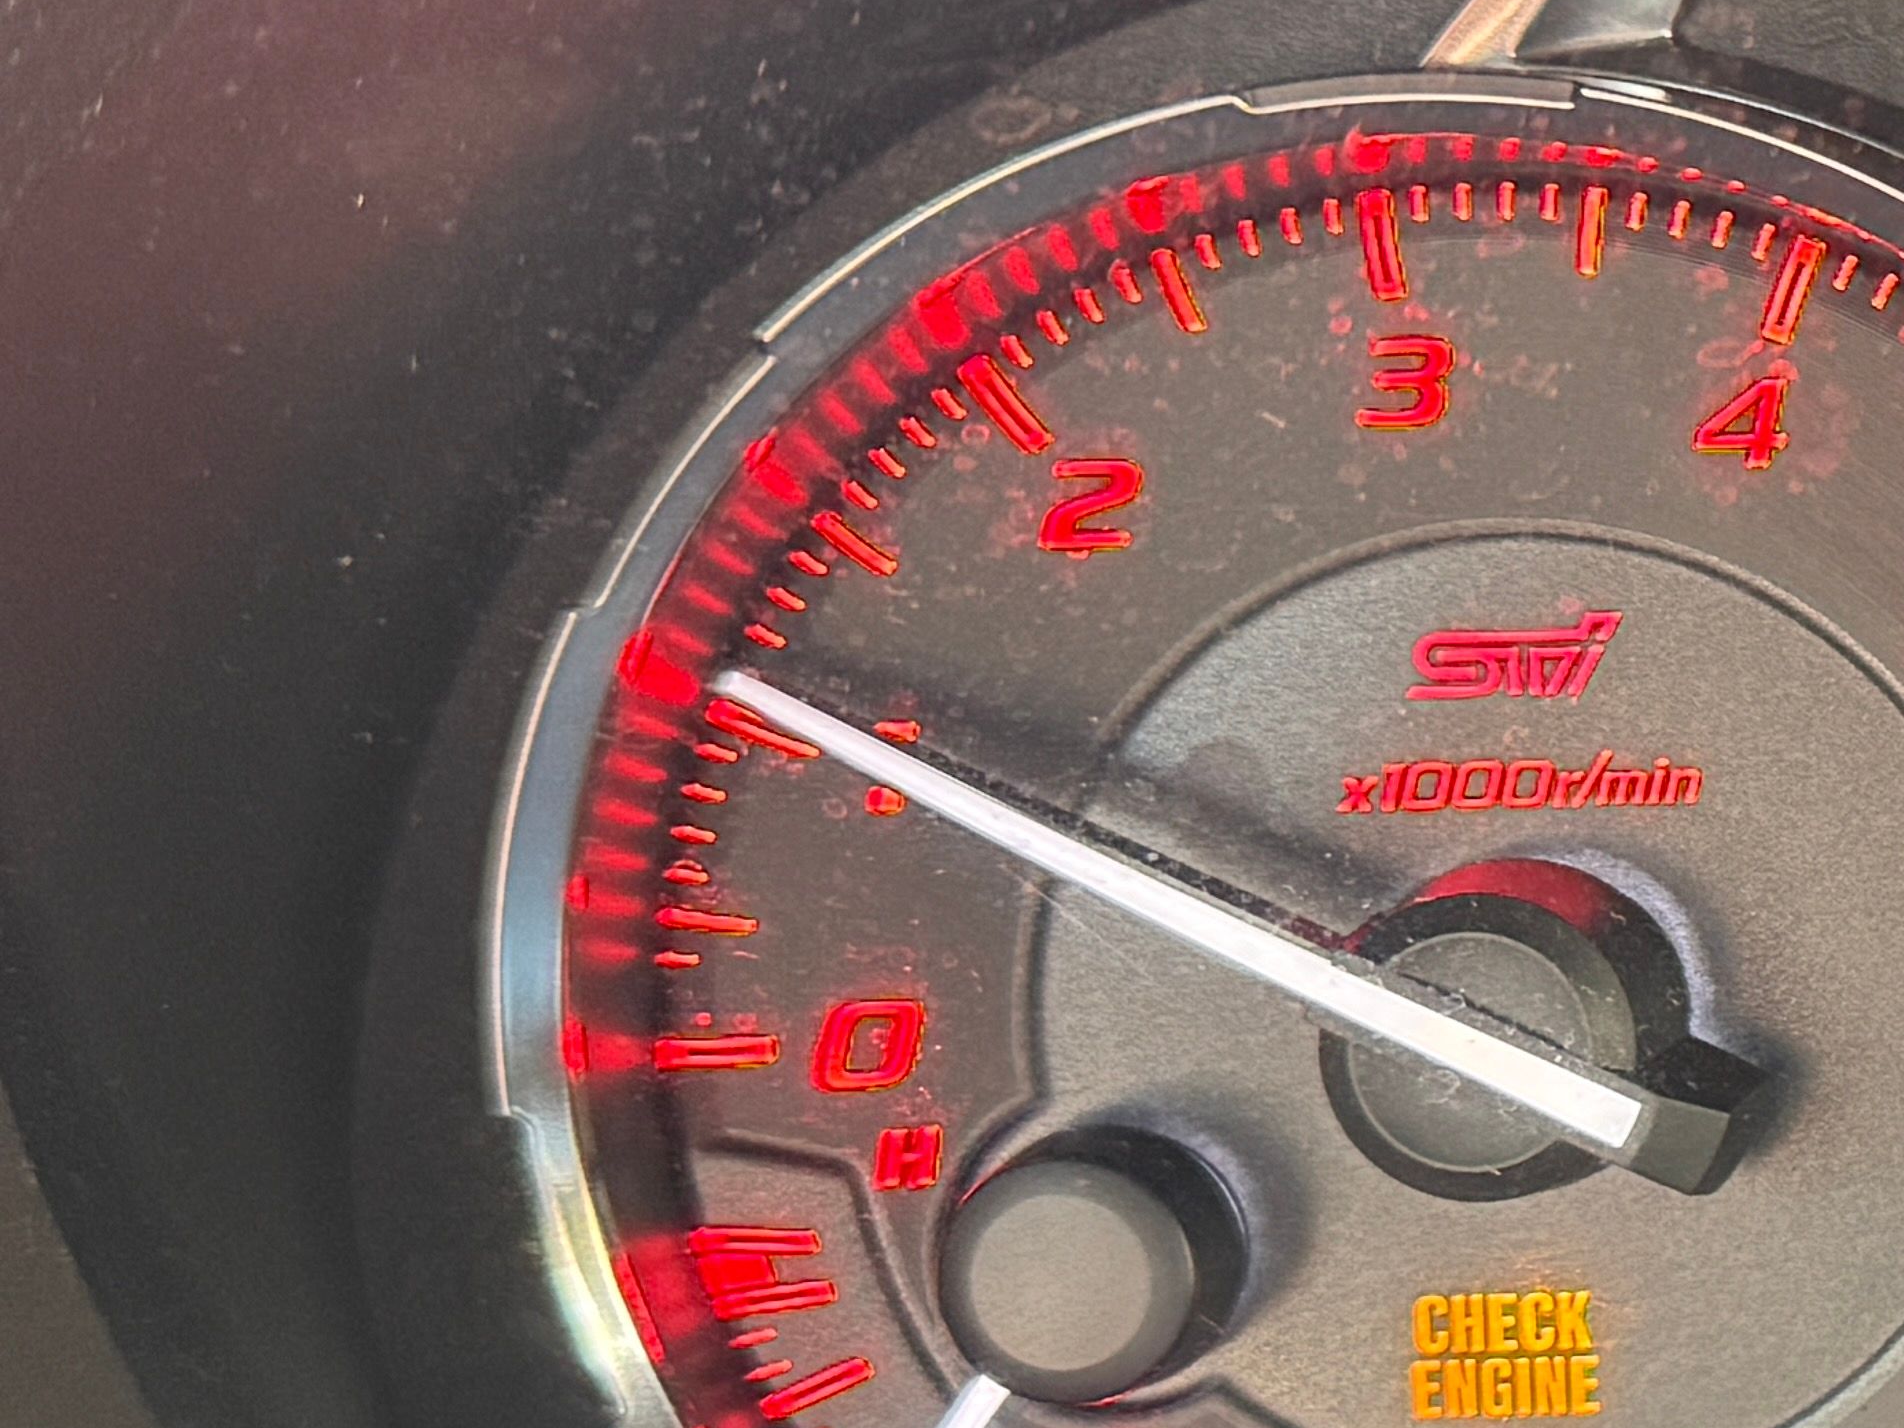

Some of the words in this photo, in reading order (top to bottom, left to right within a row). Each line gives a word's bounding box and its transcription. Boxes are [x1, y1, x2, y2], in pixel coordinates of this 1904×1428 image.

[1355, 334, 1456, 430] 3
[1691, 376, 1790, 470] 4
[1037, 458, 1144, 552] 2
[811, 997, 926, 1093] 0
[873, 1124, 944, 1191] H
[1411, 1288, 1594, 1357] CHECK
[1411, 1355, 1602, 1420] ENGINE
